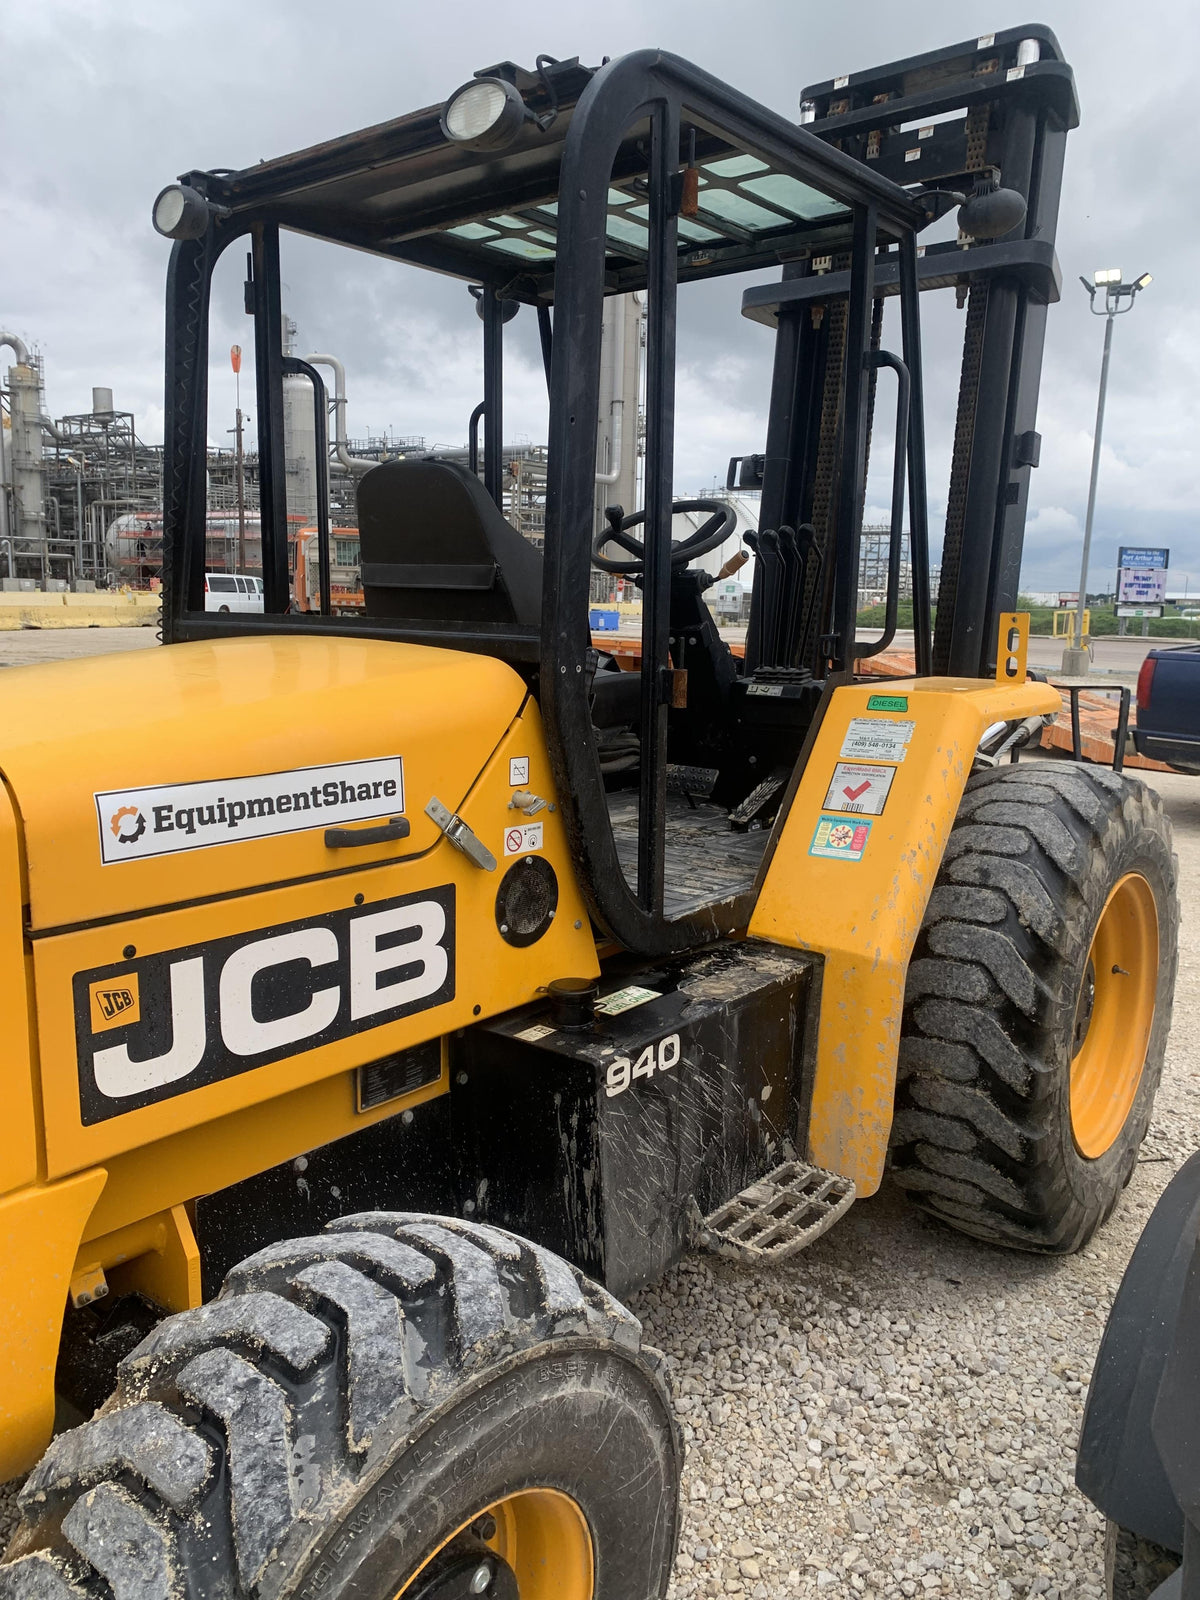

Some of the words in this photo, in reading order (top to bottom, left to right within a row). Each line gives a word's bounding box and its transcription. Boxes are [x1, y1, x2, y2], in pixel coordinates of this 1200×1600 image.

[872, 700, 904, 708] DIESEL
[152, 779, 397, 834] EquipmentShare
[93, 901, 448, 1098] JCB
[103, 992, 131, 1016] JCB
[604, 1002, 630, 1013] FUEL
[605, 1034, 680, 1097] 940
